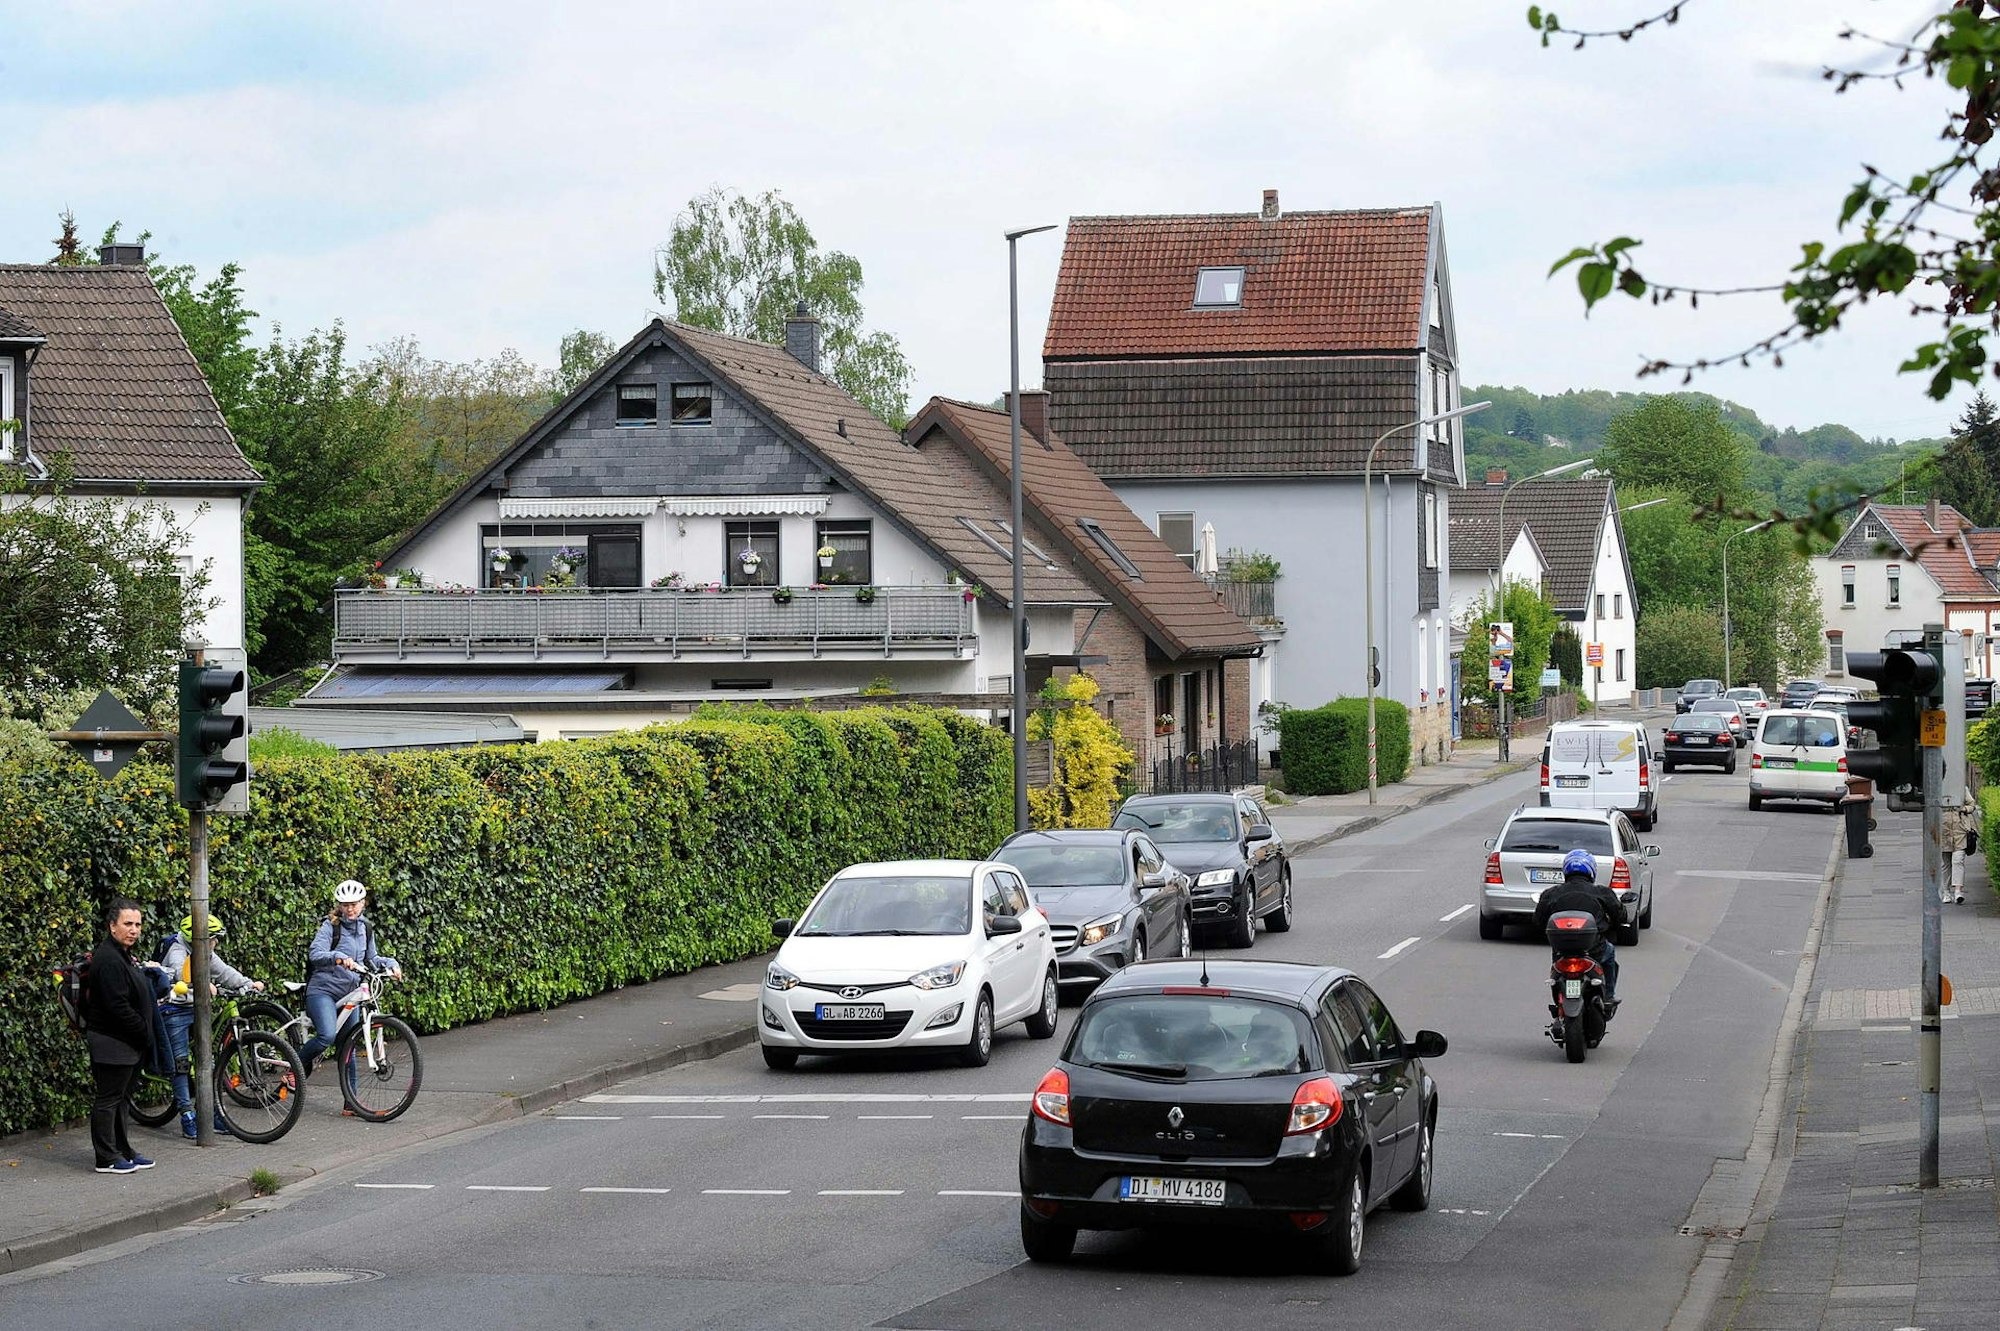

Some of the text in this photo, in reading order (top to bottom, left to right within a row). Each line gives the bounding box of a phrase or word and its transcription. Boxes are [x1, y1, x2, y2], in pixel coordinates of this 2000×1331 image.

[1536, 870, 1564, 880] GL ZA
[822, 1007, 883, 1019] GL AB 2266
[1155, 1131, 1196, 1141] CLIO
[1131, 1178, 1223, 1199] DI MV 4186
